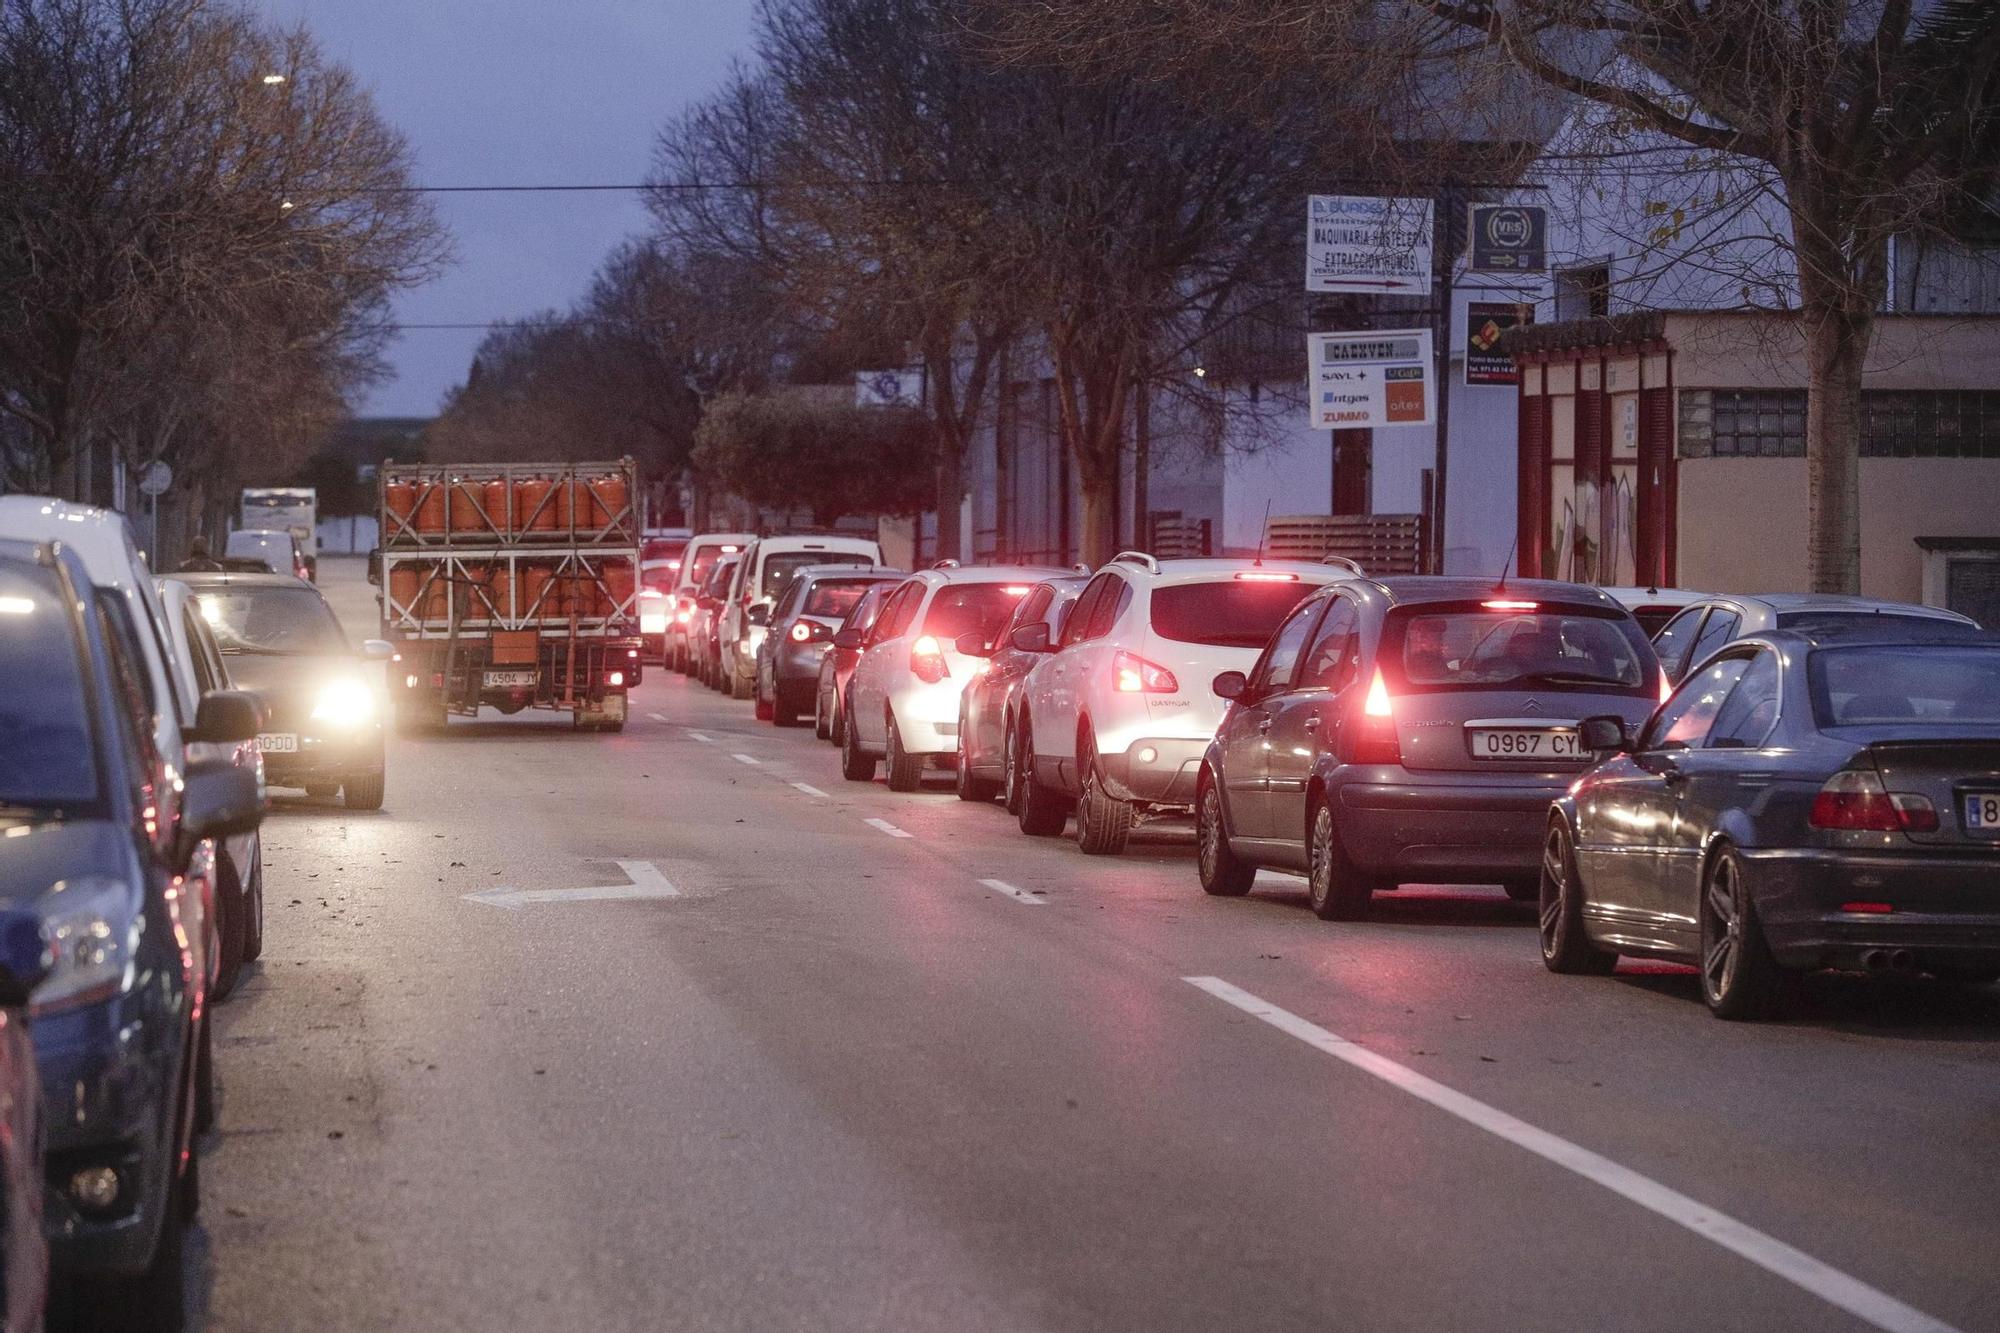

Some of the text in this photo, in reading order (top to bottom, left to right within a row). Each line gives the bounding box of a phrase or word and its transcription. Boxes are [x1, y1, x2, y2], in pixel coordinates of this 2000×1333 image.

[1314, 228, 1369, 246] MAQUINARIA
[1323, 411, 1370, 423] ZUMMO
[491, 673, 517, 684] 4504
[1487, 734, 1541, 753] 0967
[1984, 799, 1998, 823] 8
